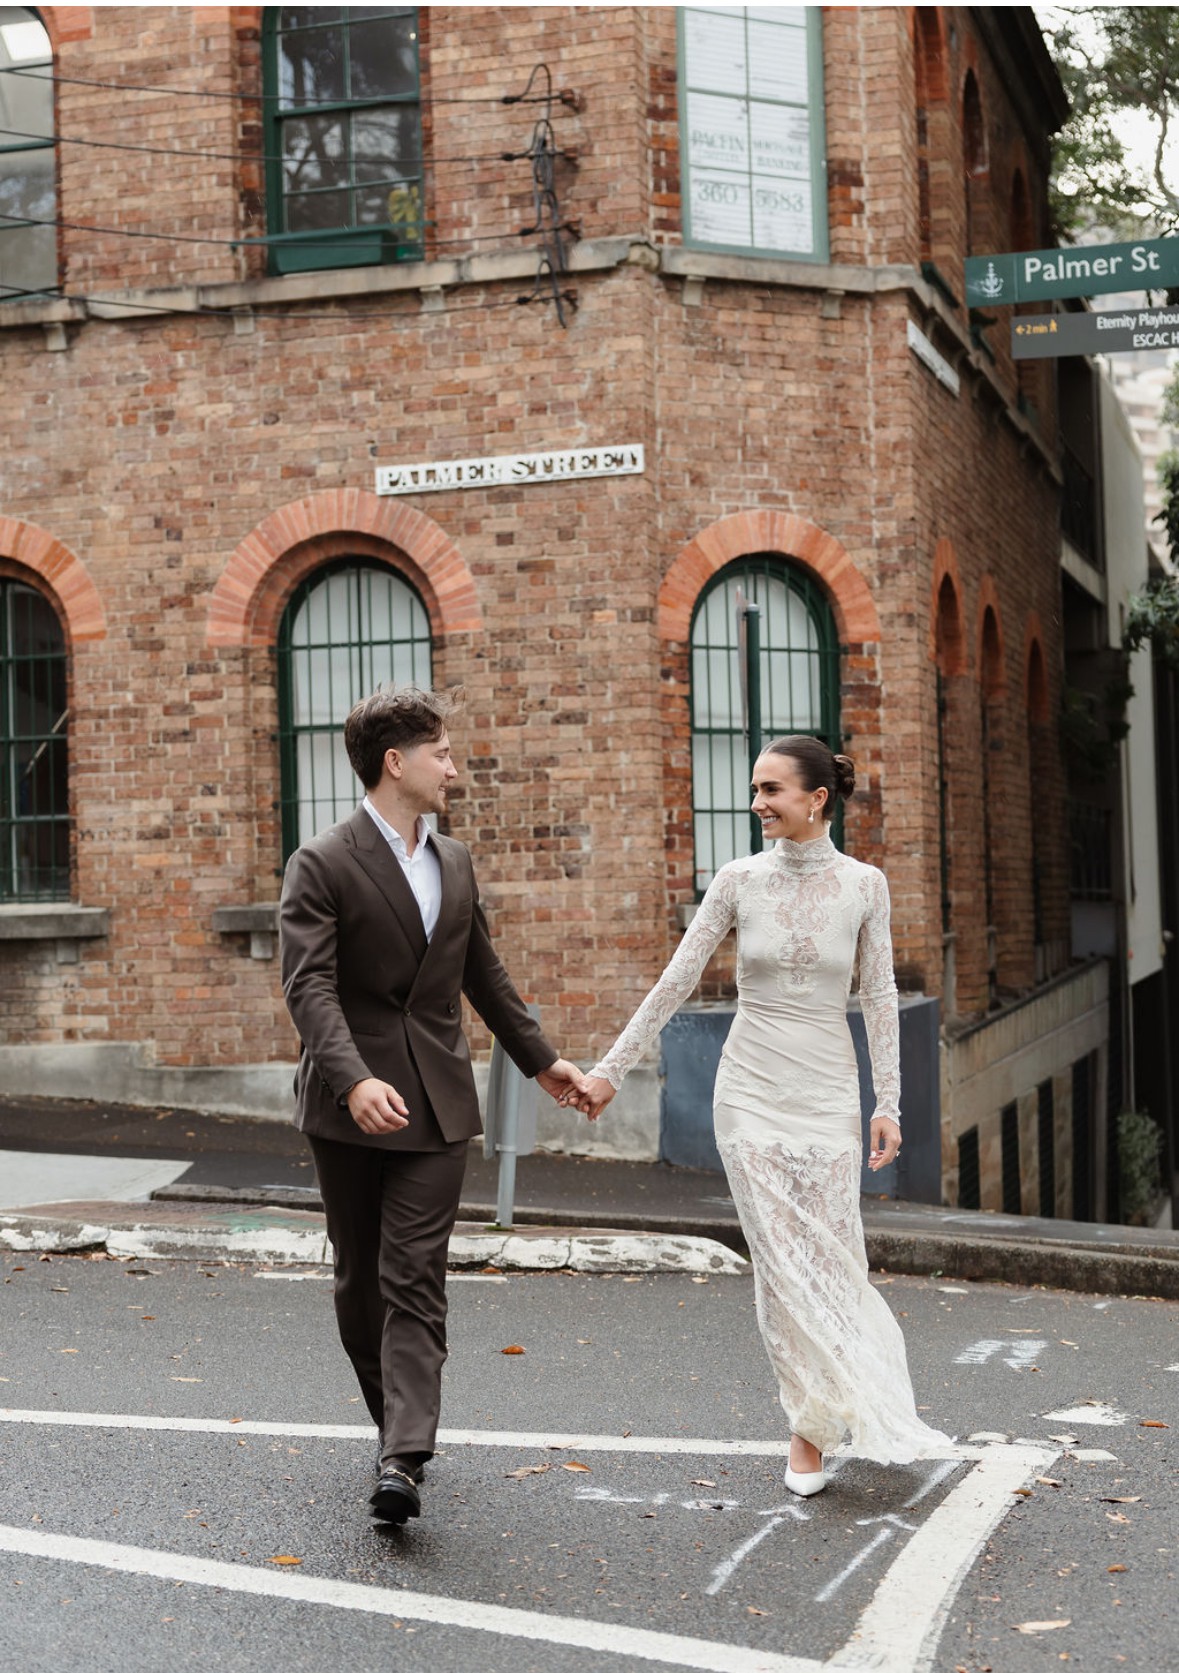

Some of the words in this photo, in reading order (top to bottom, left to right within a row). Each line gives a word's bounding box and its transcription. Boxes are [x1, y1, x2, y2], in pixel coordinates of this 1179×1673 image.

[1025, 254, 1122, 283] Palmer
[1131, 246, 1160, 273] St
[1096, 314, 1136, 331] Eternity
[1133, 332, 1170, 347] ESCAC
[381, 459, 501, 490] PALMER
[511, 450, 639, 480] STREET
